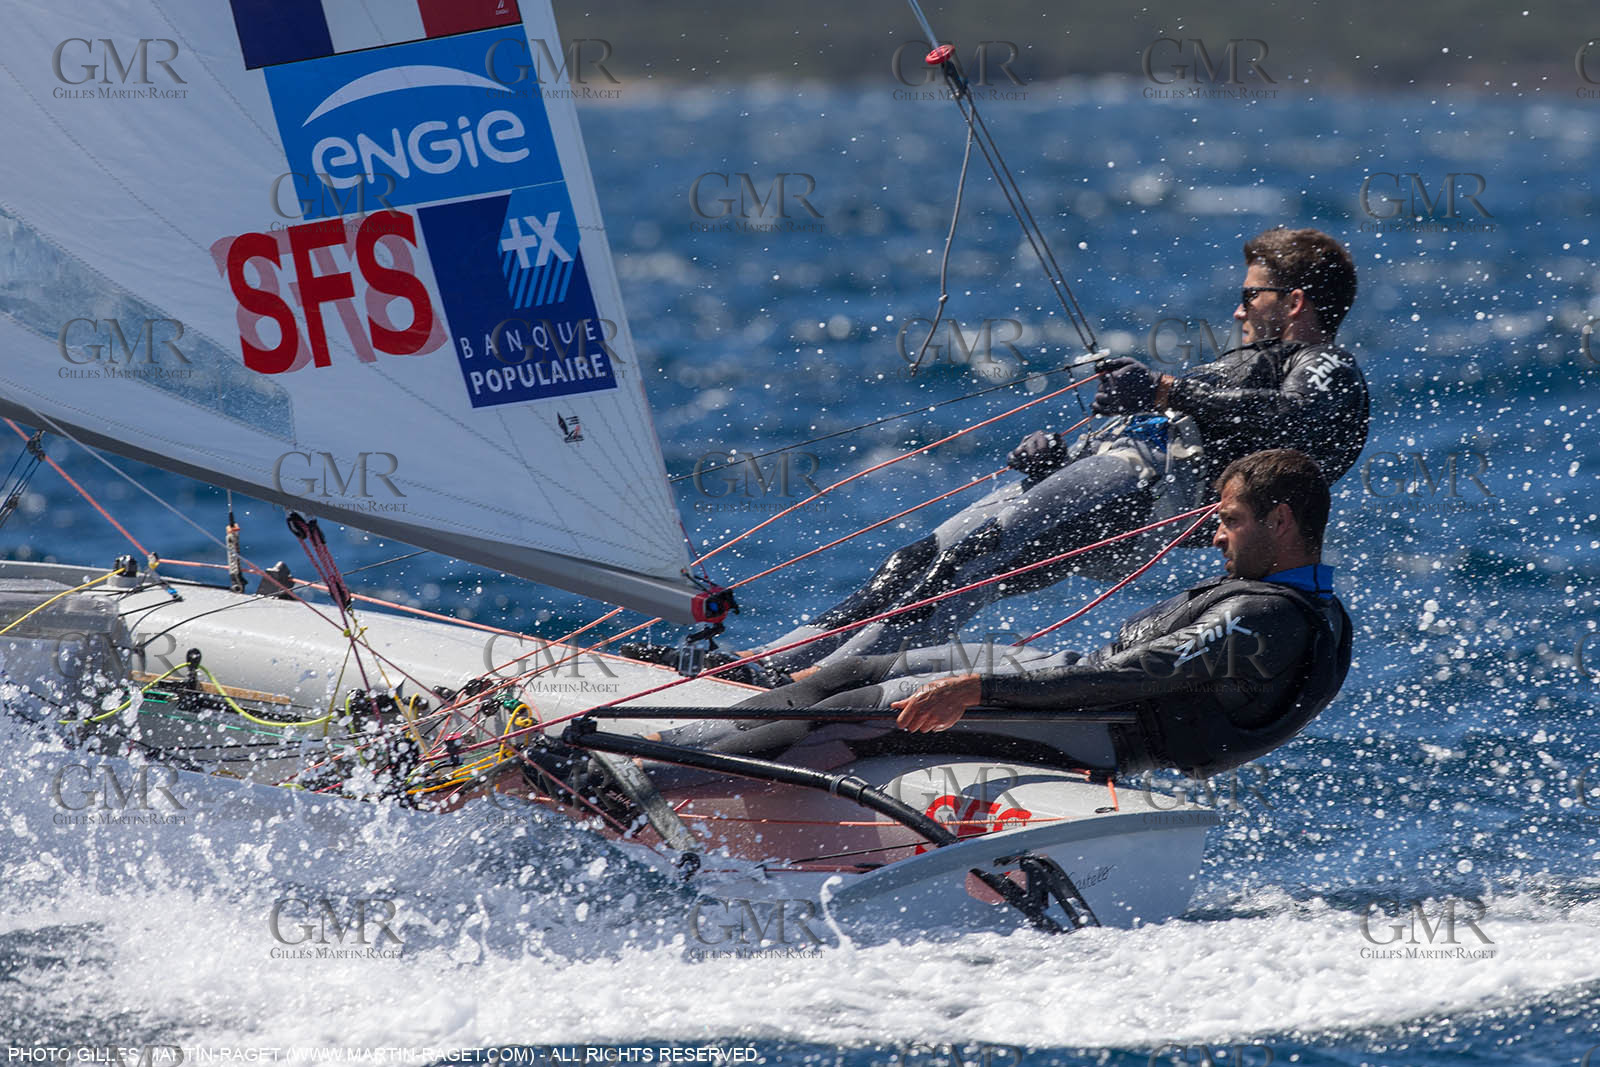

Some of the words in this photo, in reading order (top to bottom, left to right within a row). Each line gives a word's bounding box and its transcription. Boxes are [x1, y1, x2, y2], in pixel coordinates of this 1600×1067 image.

[226, 210, 434, 374] SFS
[460, 319, 596, 359] BANQUE
[470, 354, 606, 395] POPULAIRE
